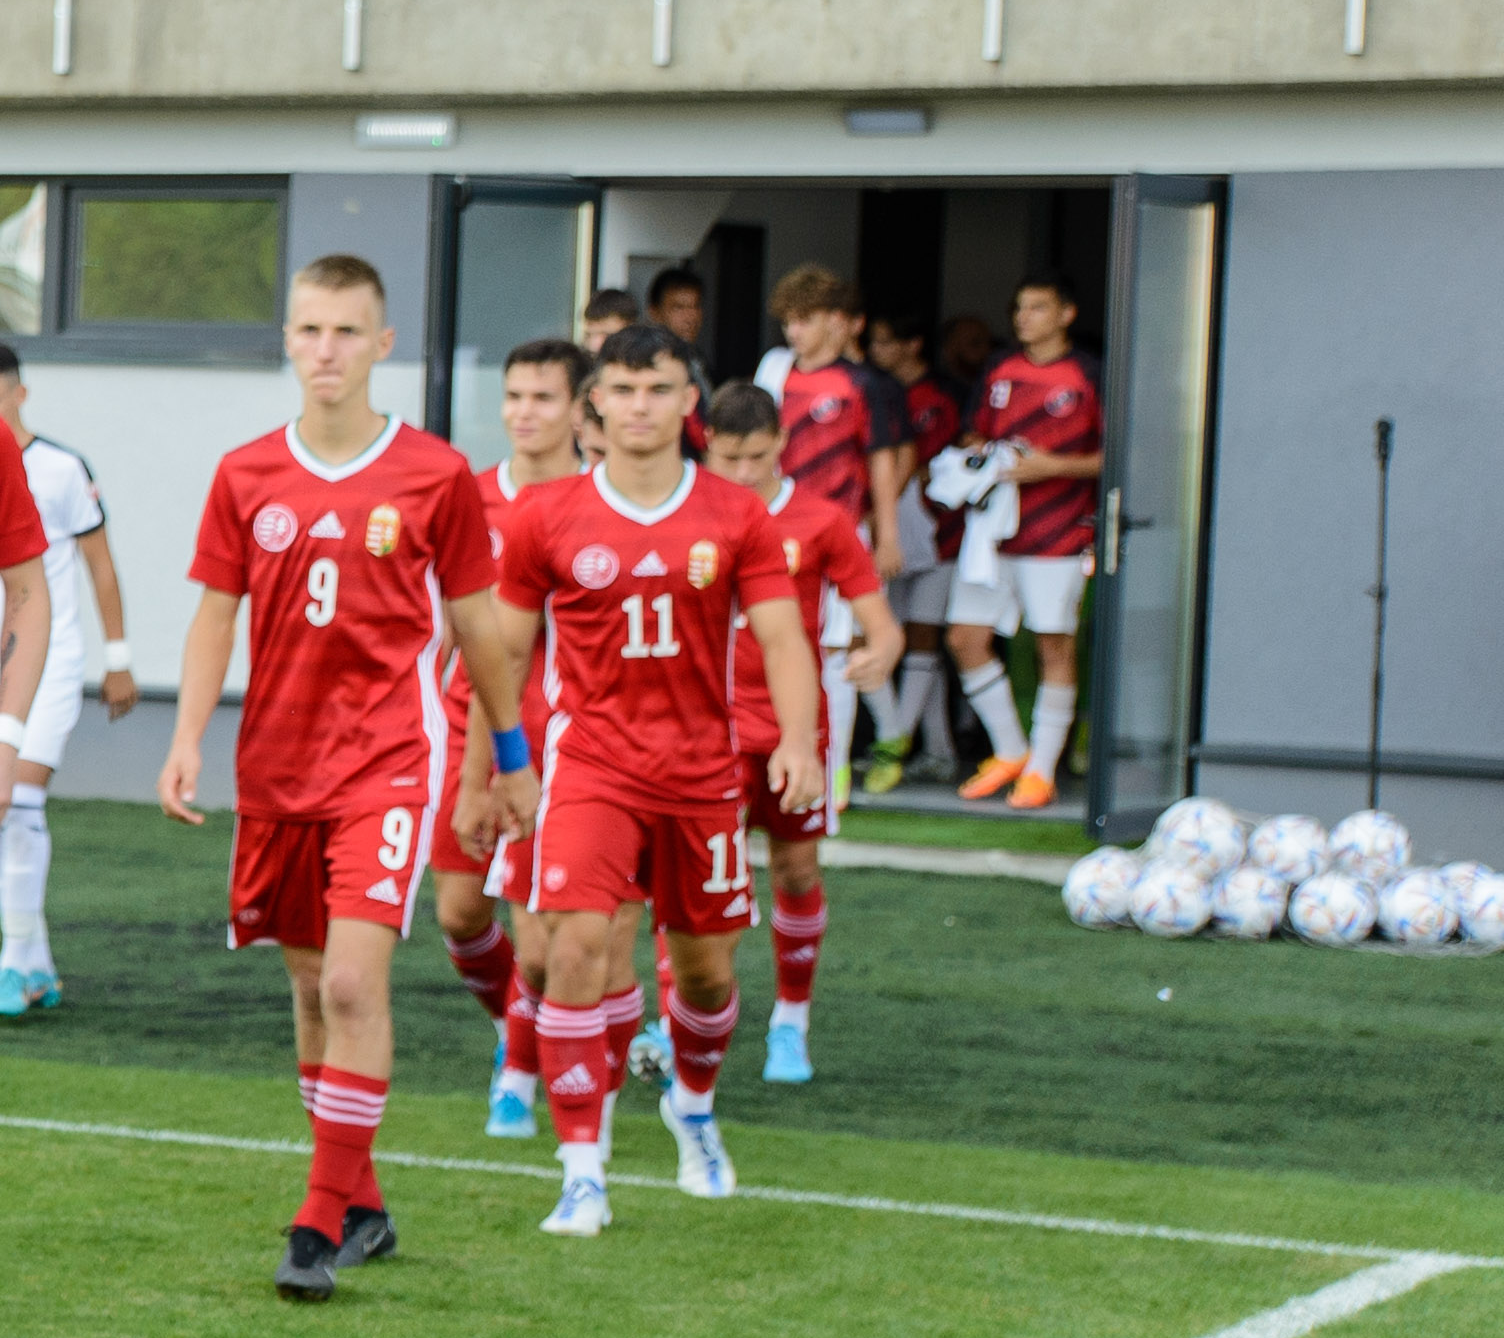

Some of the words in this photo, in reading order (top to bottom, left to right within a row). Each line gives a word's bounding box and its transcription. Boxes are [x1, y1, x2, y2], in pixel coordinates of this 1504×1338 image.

[305, 557, 340, 628] 9
[620, 593, 681, 659] 11
[378, 806, 413, 871] 9
[702, 830, 750, 894] 11
